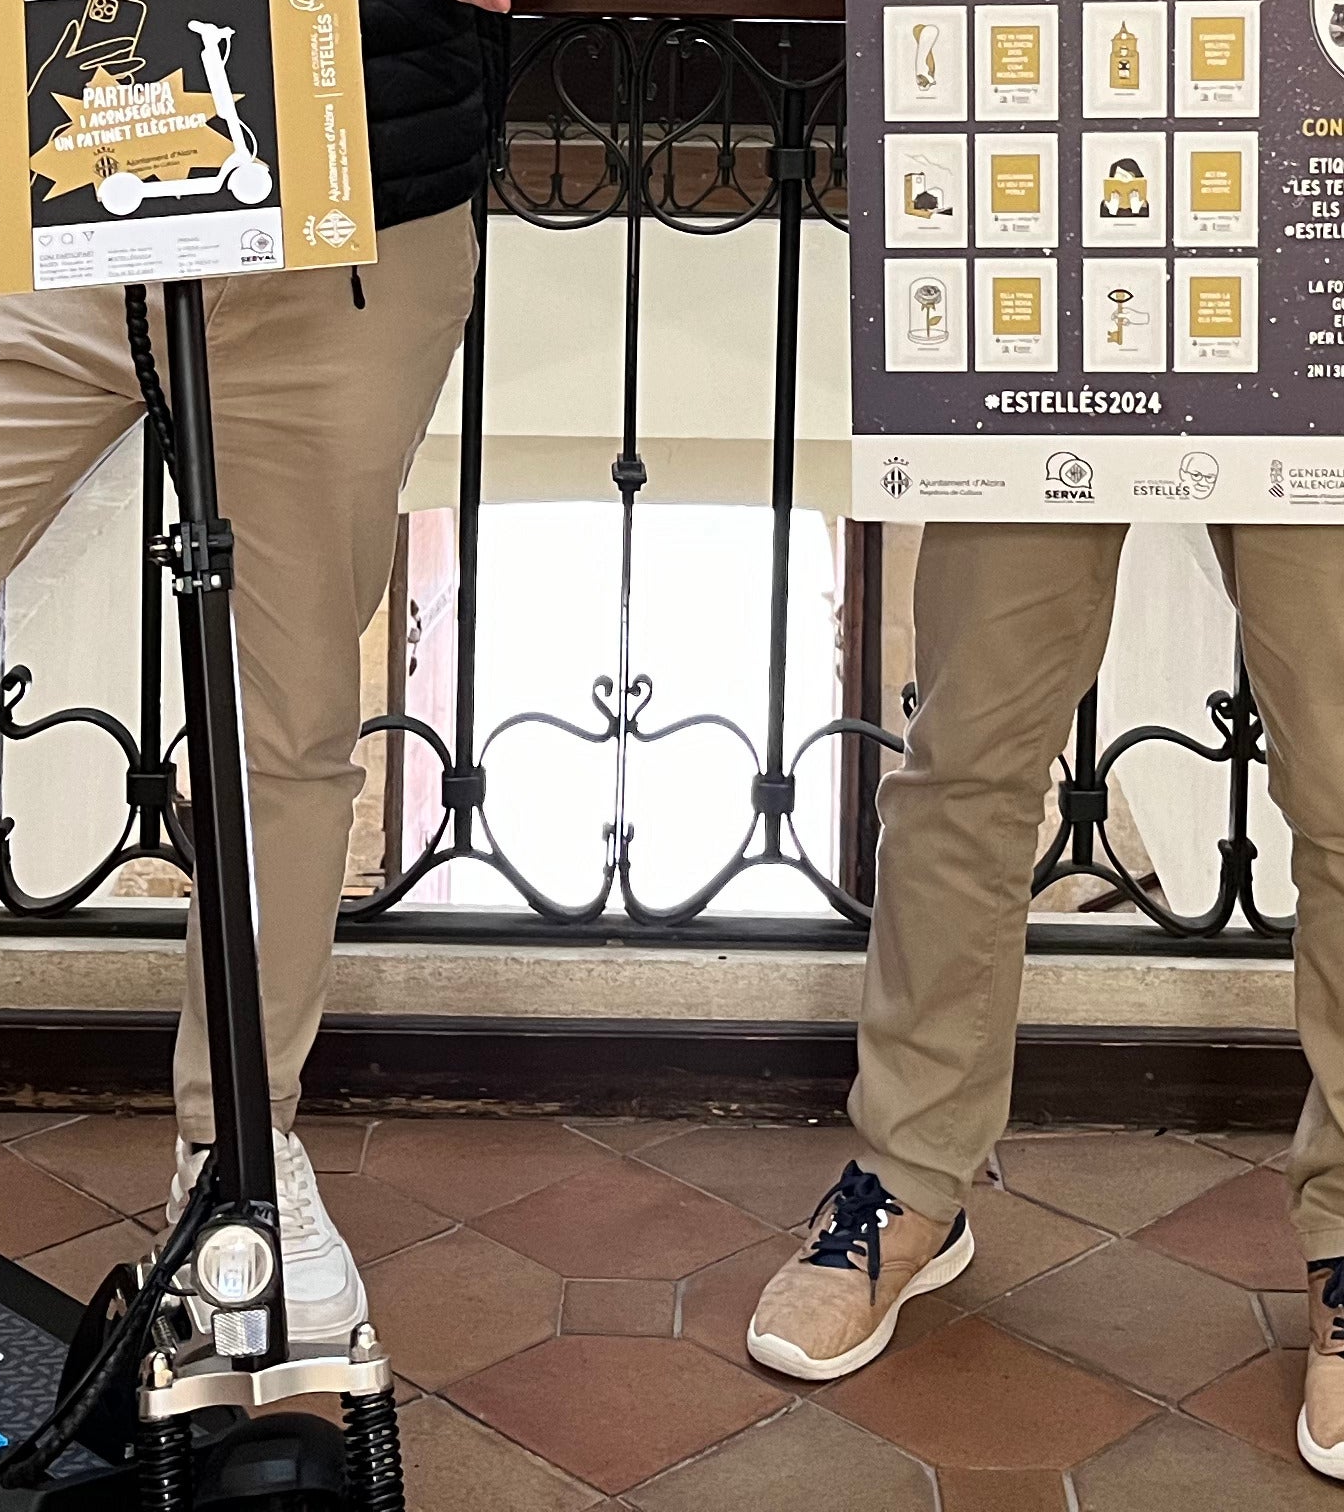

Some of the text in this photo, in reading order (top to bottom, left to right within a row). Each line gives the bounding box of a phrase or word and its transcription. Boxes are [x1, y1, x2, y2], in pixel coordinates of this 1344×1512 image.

[313, 13, 336, 87] ESTELLÉS
[82, 82, 174, 110] PARTICIPA
[79, 99, 176, 129] I ACONSEGUIX
[54, 136, 74, 152] UN
[77, 125, 132, 148] PATINET
[1293, 180, 1320, 195] LES
[1313, 201, 1340, 217] ELS
[1308, 280, 1324, 293] LA
[1309, 332, 1334, 344] PER
[1307, 365, 1323, 378] 2N
[1326, 365, 1331, 377] I
[984, 385, 1162, 414] #ESTELLÉS2024
[919, 479, 970, 488] Ajuntament
[1133, 483, 1190, 496] ESTELLÉS
[1045, 490, 1095, 499] SERVAL
